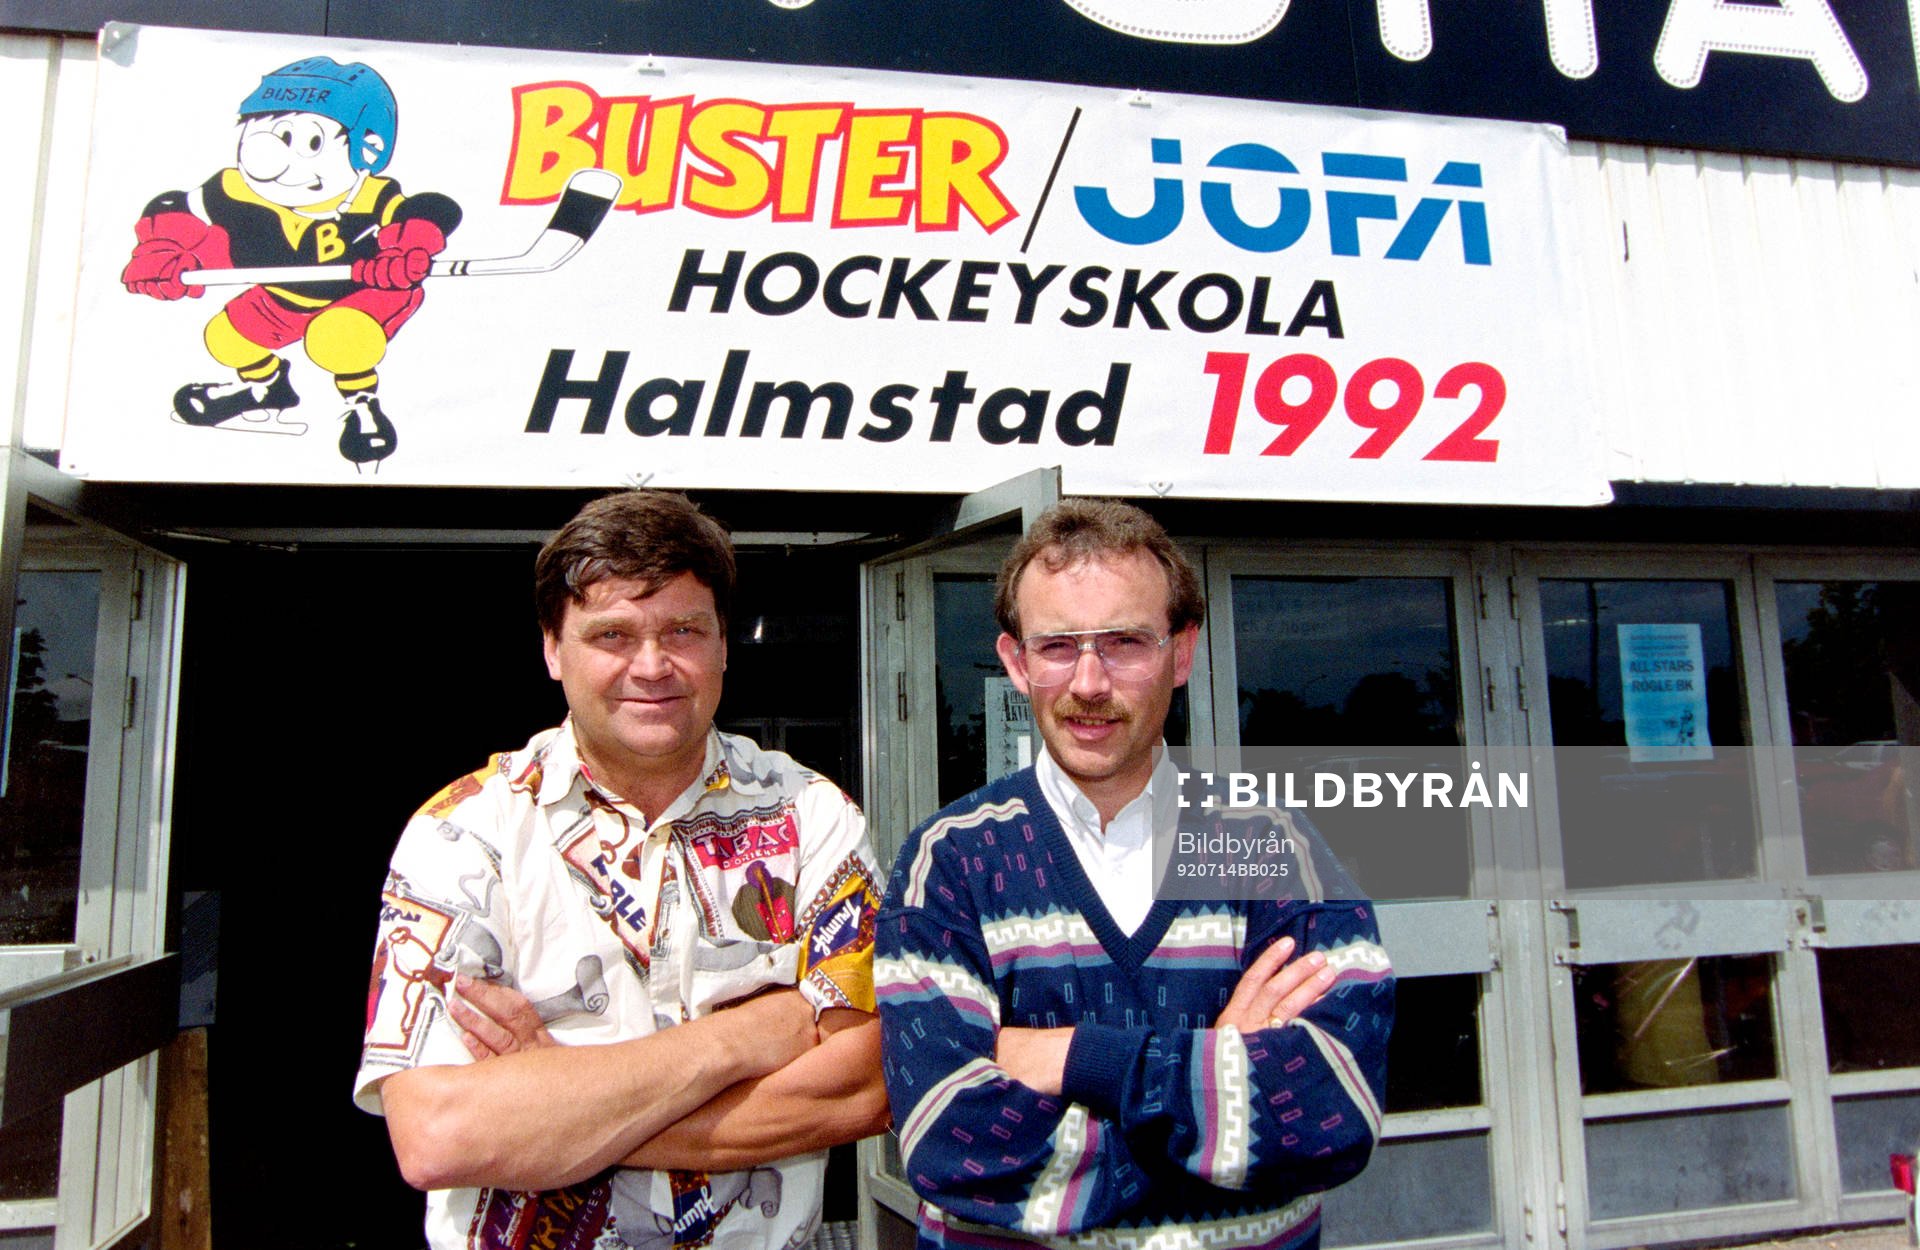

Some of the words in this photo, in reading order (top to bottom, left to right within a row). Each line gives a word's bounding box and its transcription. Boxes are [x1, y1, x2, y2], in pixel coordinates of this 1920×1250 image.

[262, 87, 332, 104] BUSTER
[500, 81, 1019, 234] BUSTER
[1074, 138, 1492, 266] JOFA
[668, 248, 1345, 339] HOCKEYSKOLA
[524, 349, 1132, 447] Halmstad
[1203, 351, 1507, 463] 1992
[1654, 659, 1695, 673] STARS
